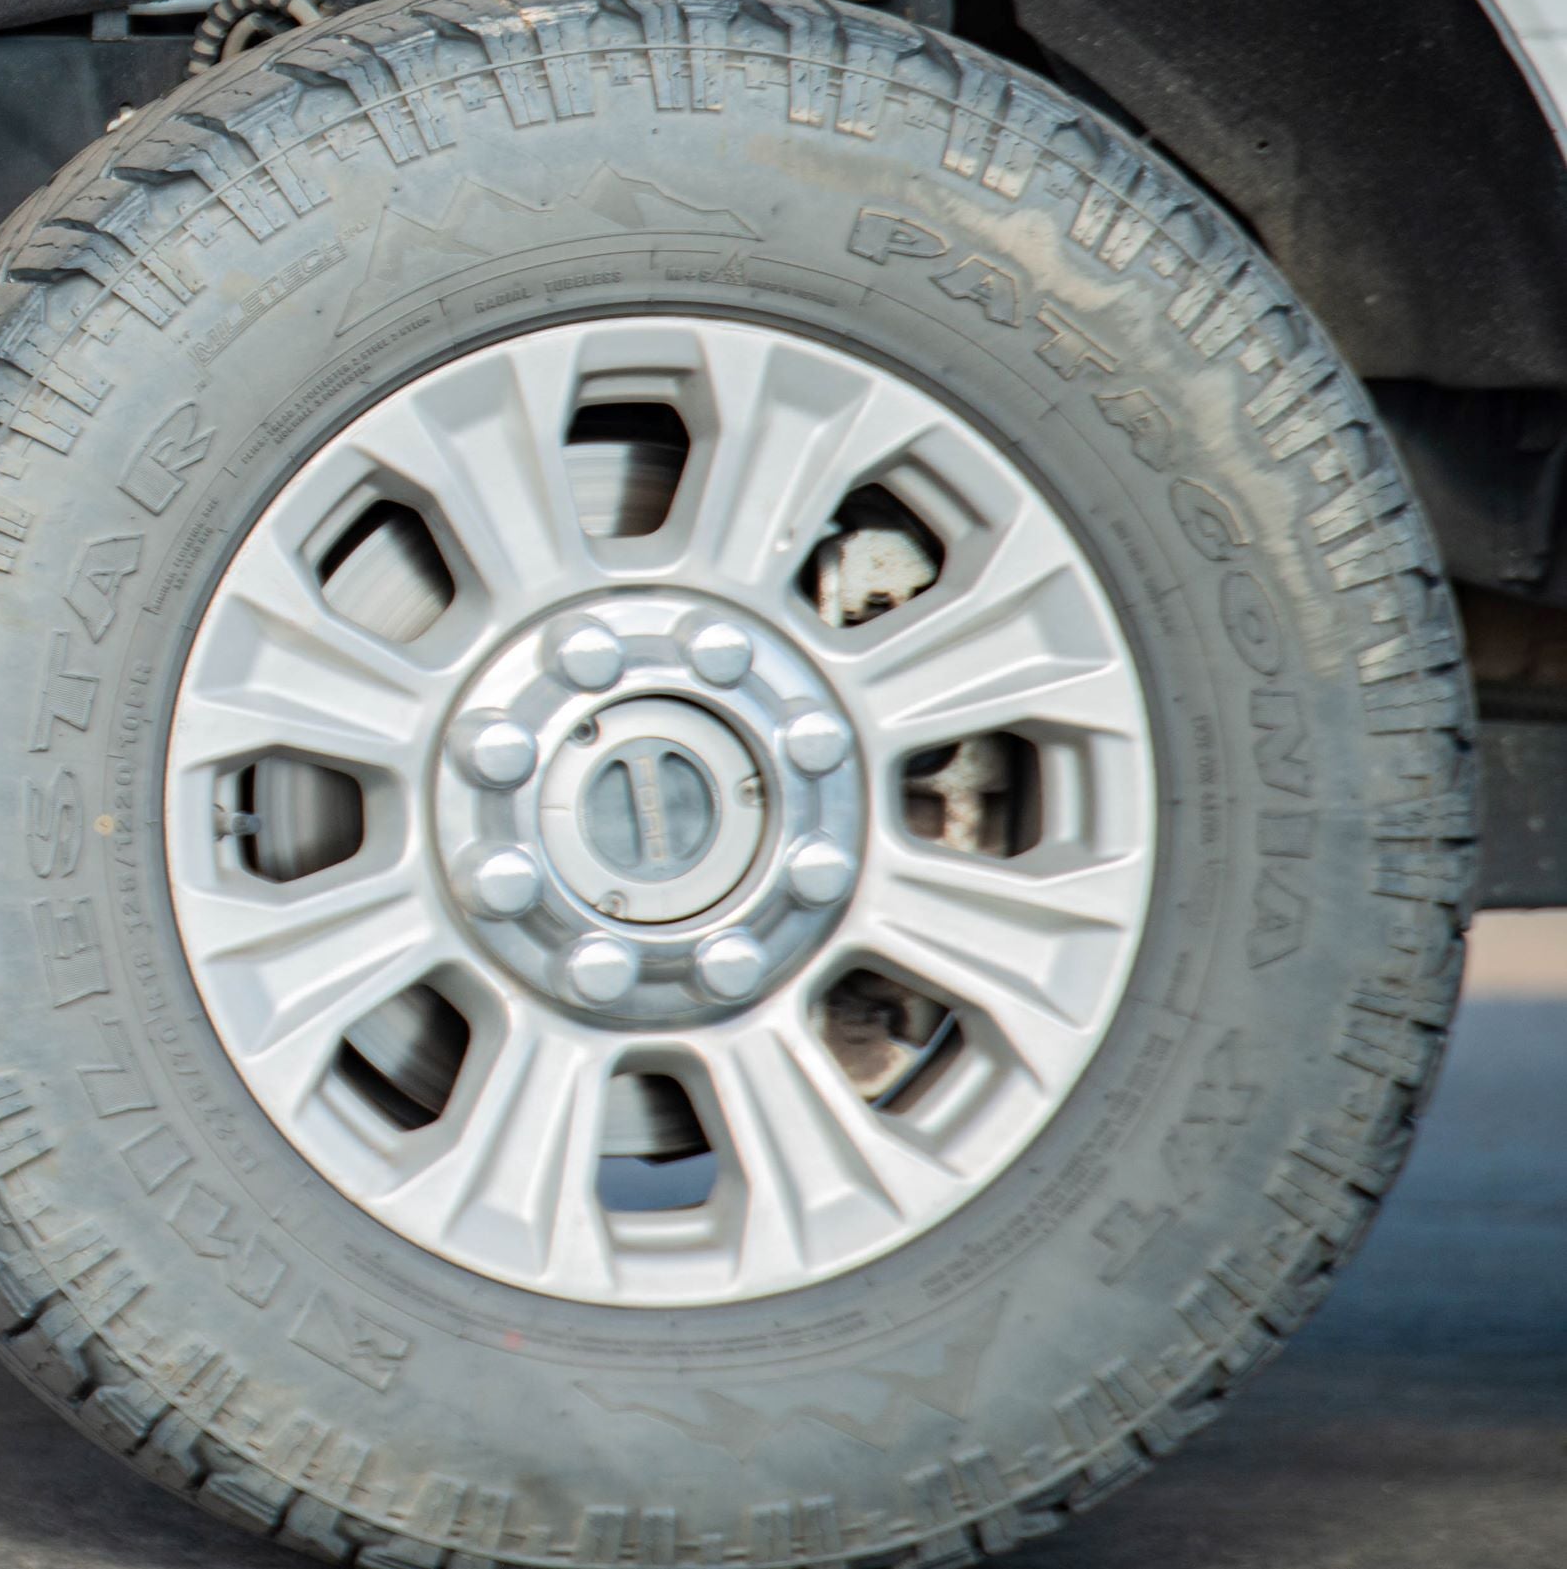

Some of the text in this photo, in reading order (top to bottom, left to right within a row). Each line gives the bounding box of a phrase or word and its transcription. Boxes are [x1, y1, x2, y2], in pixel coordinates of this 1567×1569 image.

[189, 243, 348, 367] MILETECH
[474, 271, 622, 314] RADIAL TUBELESS
[847, 205, 1312, 971] PATAGONIA
[29, 400, 289, 1305] MILESTAR
